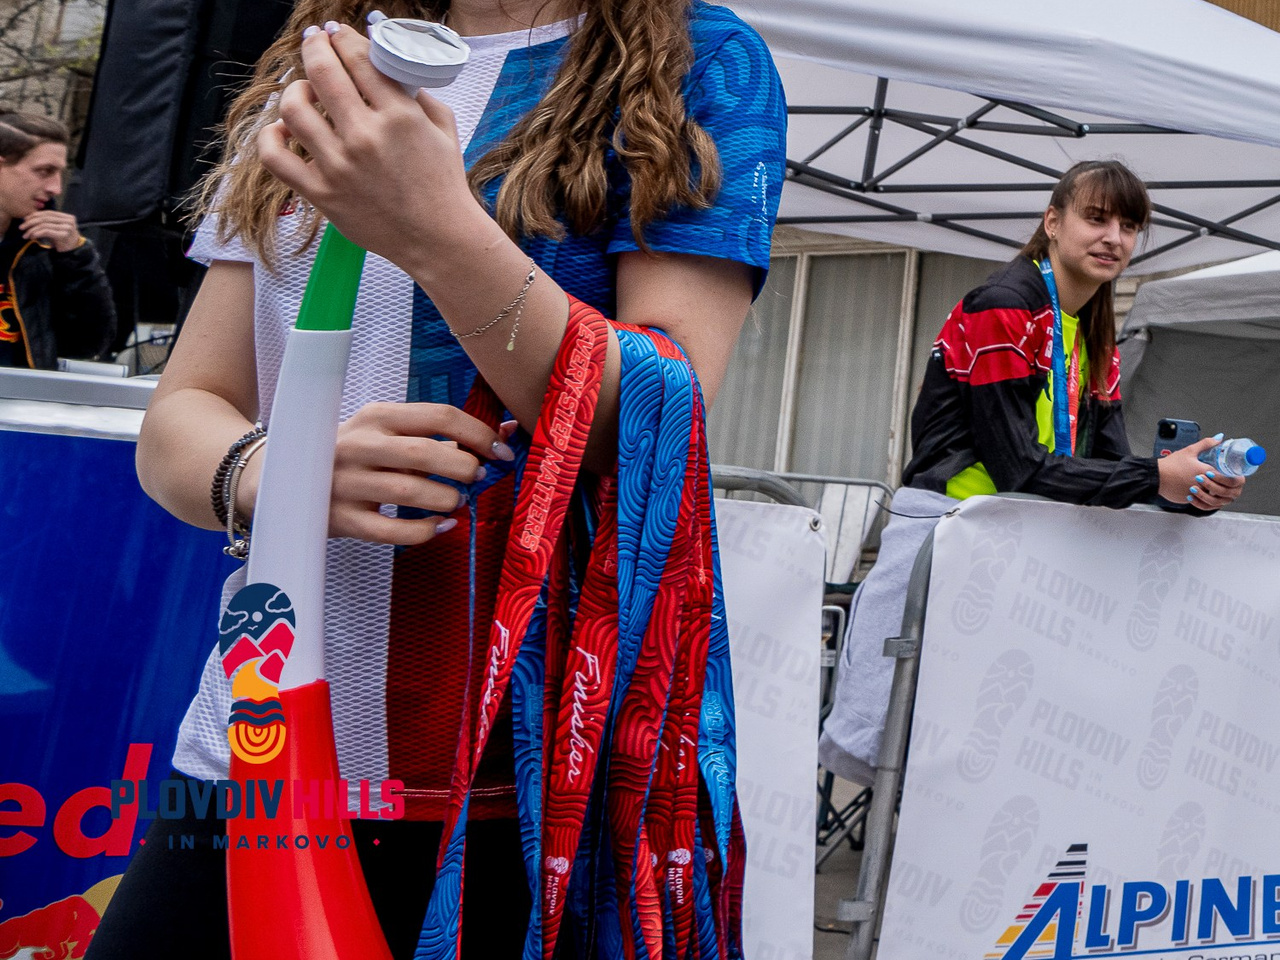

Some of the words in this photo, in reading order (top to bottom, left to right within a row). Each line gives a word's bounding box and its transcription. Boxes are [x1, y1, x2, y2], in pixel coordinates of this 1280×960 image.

[565, 322, 596, 398] EVERY
[550, 392, 579, 452] STEP
[520, 446, 564, 554] MATTERS
[1008, 591, 1076, 648] HILLS
[1021, 554, 1119, 626] PLOVDIV
[1183, 575, 1275, 642] PLOVDIV
[1173, 610, 1236, 662] HILLS
[567, 646, 600, 784] Finisher
[1029, 697, 1132, 767] PLOVDIV
[1013, 735, 1085, 791] HILLS
[1184, 745, 1242, 796] HILLS
[675, 867, 684, 905] PLOVDIV
